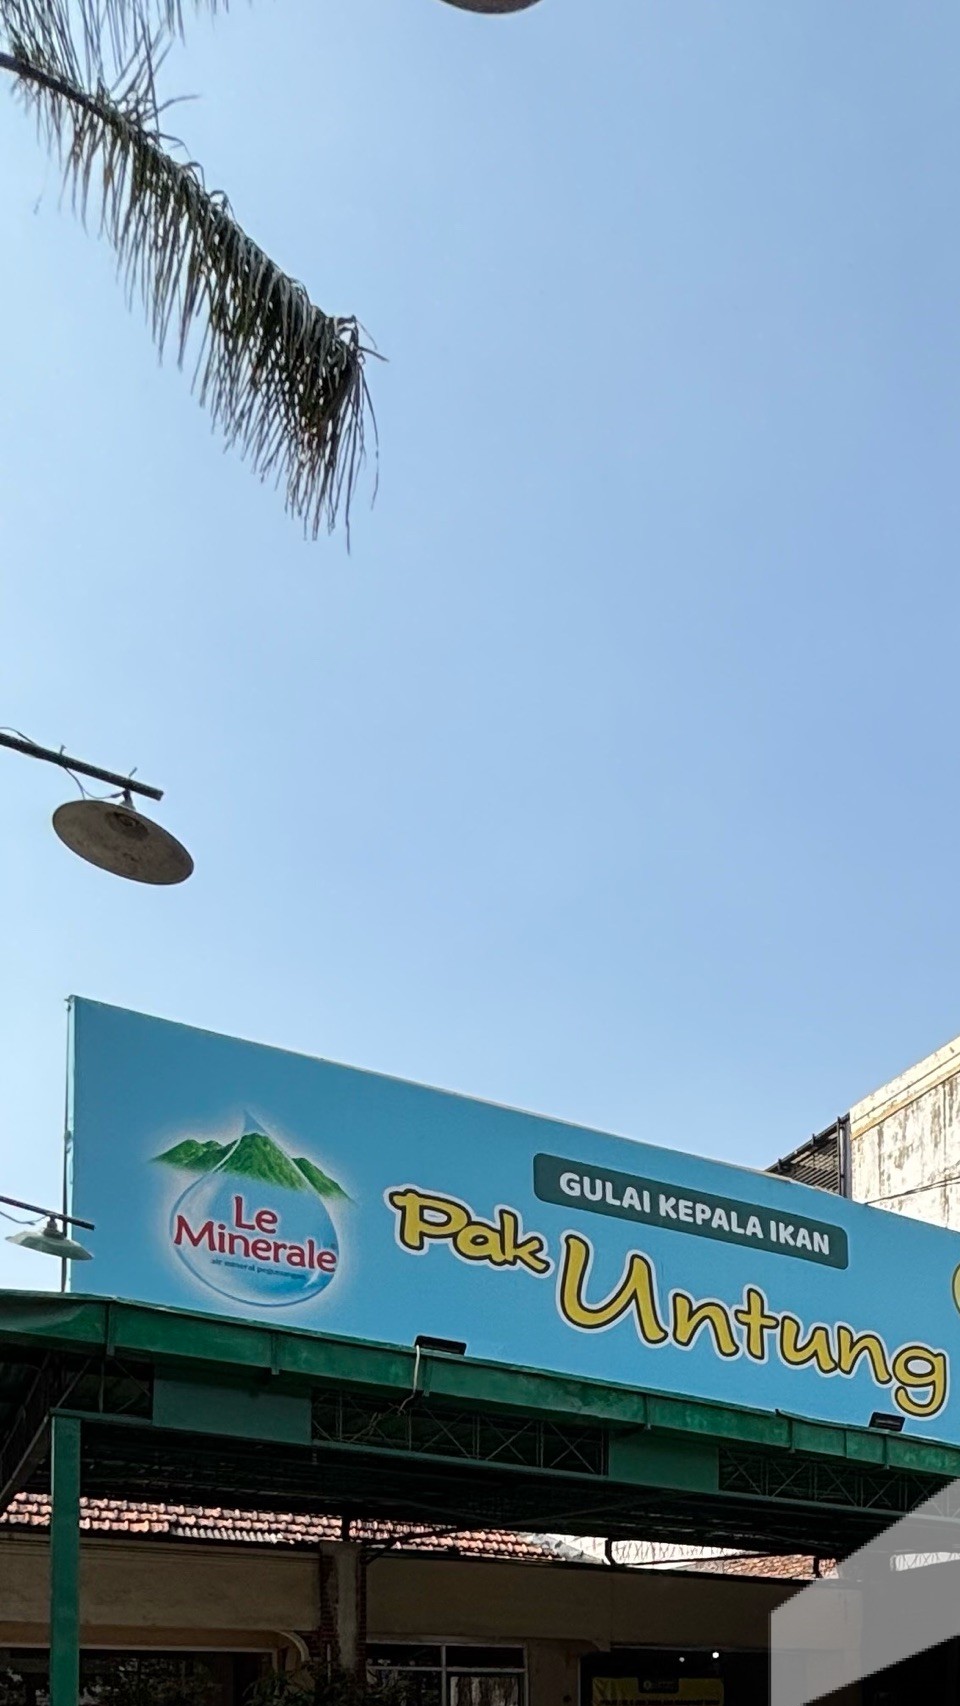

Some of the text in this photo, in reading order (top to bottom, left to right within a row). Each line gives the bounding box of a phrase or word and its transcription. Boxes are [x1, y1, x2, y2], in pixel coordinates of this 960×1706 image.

[173, 1214, 337, 1273] Minerale
[234, 1195, 278, 1234] Le
[389, 1188, 550, 1274] Pak
[559, 1171, 830, 1255] GULAI KEPALA IKAN
[561, 1235, 948, 1418] Untung
